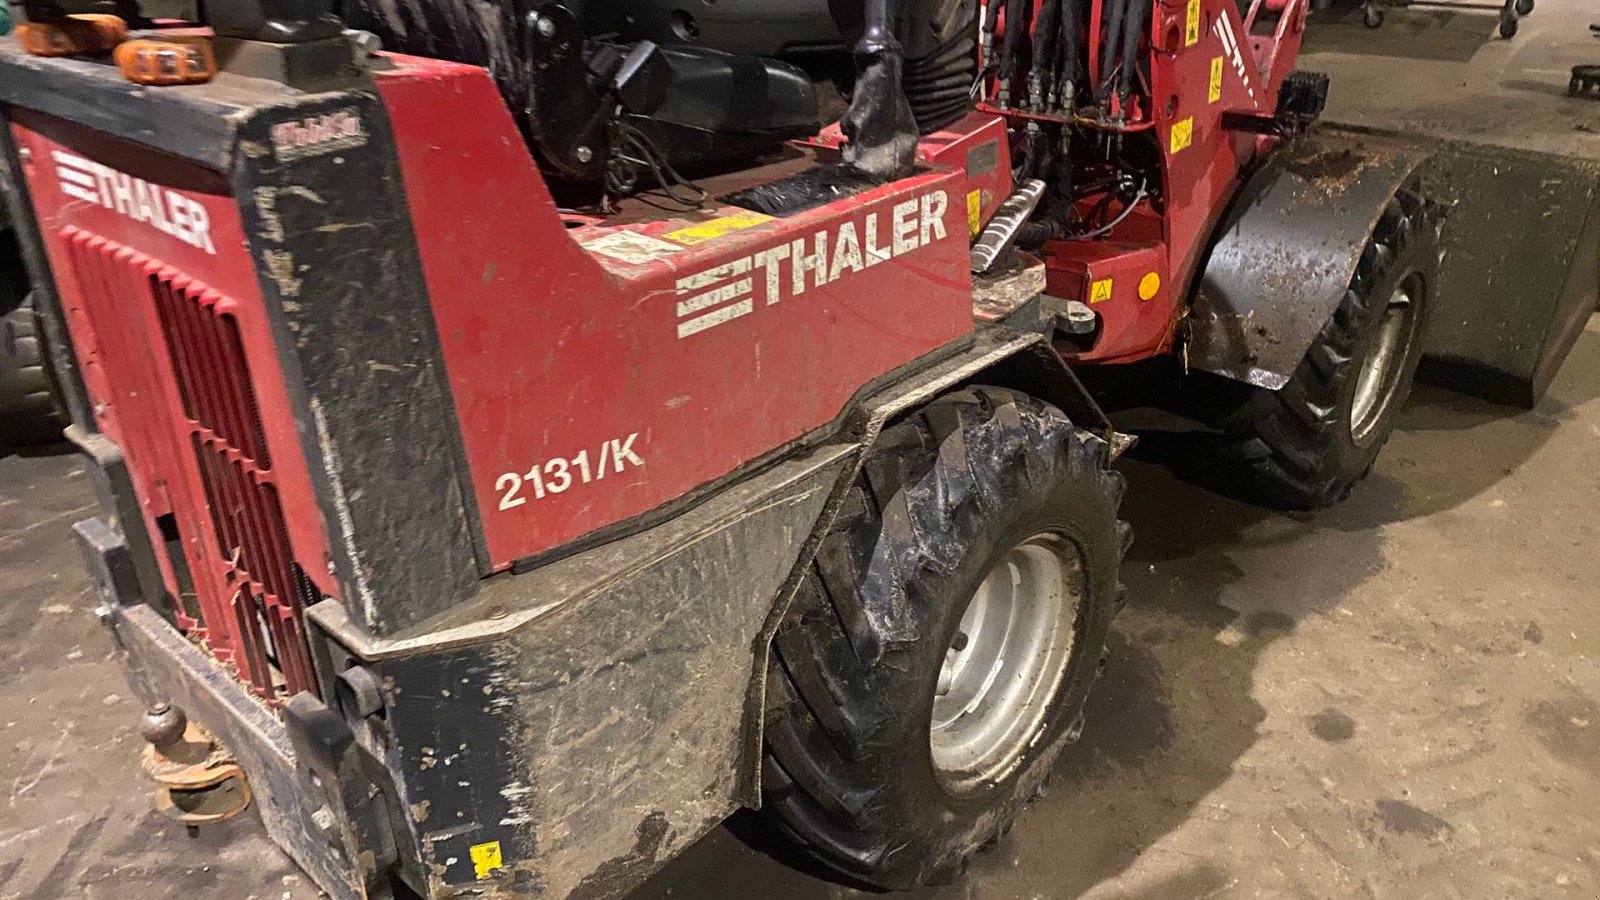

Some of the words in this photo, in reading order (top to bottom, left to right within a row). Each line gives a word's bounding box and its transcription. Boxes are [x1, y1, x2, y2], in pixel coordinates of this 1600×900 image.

[94, 161, 217, 255] THALER
[755, 190, 948, 305] THALER
[495, 432, 645, 511] 2131/K
